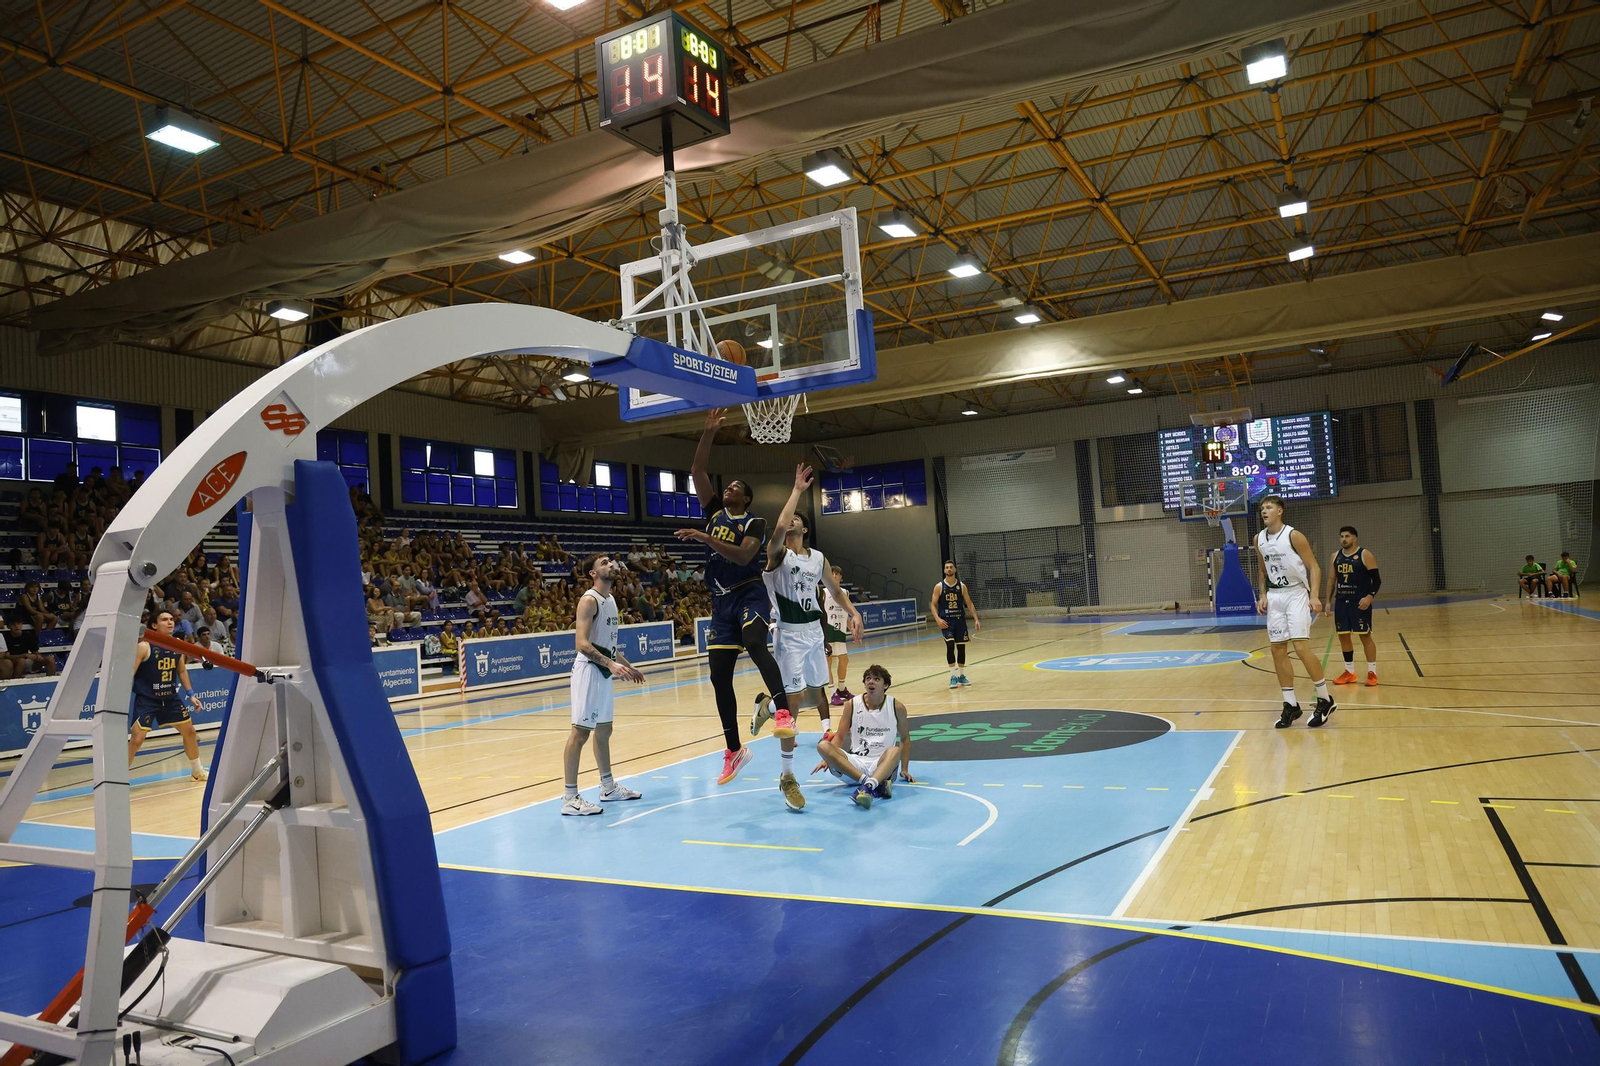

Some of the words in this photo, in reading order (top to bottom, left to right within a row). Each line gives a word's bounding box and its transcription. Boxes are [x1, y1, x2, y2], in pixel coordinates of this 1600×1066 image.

[624, 55, 663, 106] 14
[692, 64, 720, 116] 14
[672, 352, 704, 372] SPORT
[704, 361, 738, 380] SYSTEM
[1208, 450, 1220, 460] 14
[1256, 448, 1266, 461] 0
[1232, 464, 1260, 476] 8:02
[198, 462, 235, 507] ACE
[1338, 564, 1354, 574] CBA
[1277, 576, 1289, 586] 23
[1343, 574, 1348, 583] 7
[946, 593, 958, 601] CBA
[158, 657, 176, 670] CBA
[491, 655, 523, 665] Ayuntamiento
[498, 664, 521, 674] Algeciras
[162, 671, 172, 682] 21
[382, 678, 412, 688] Algeciras
[1010, 714, 1106, 752] damex.io
